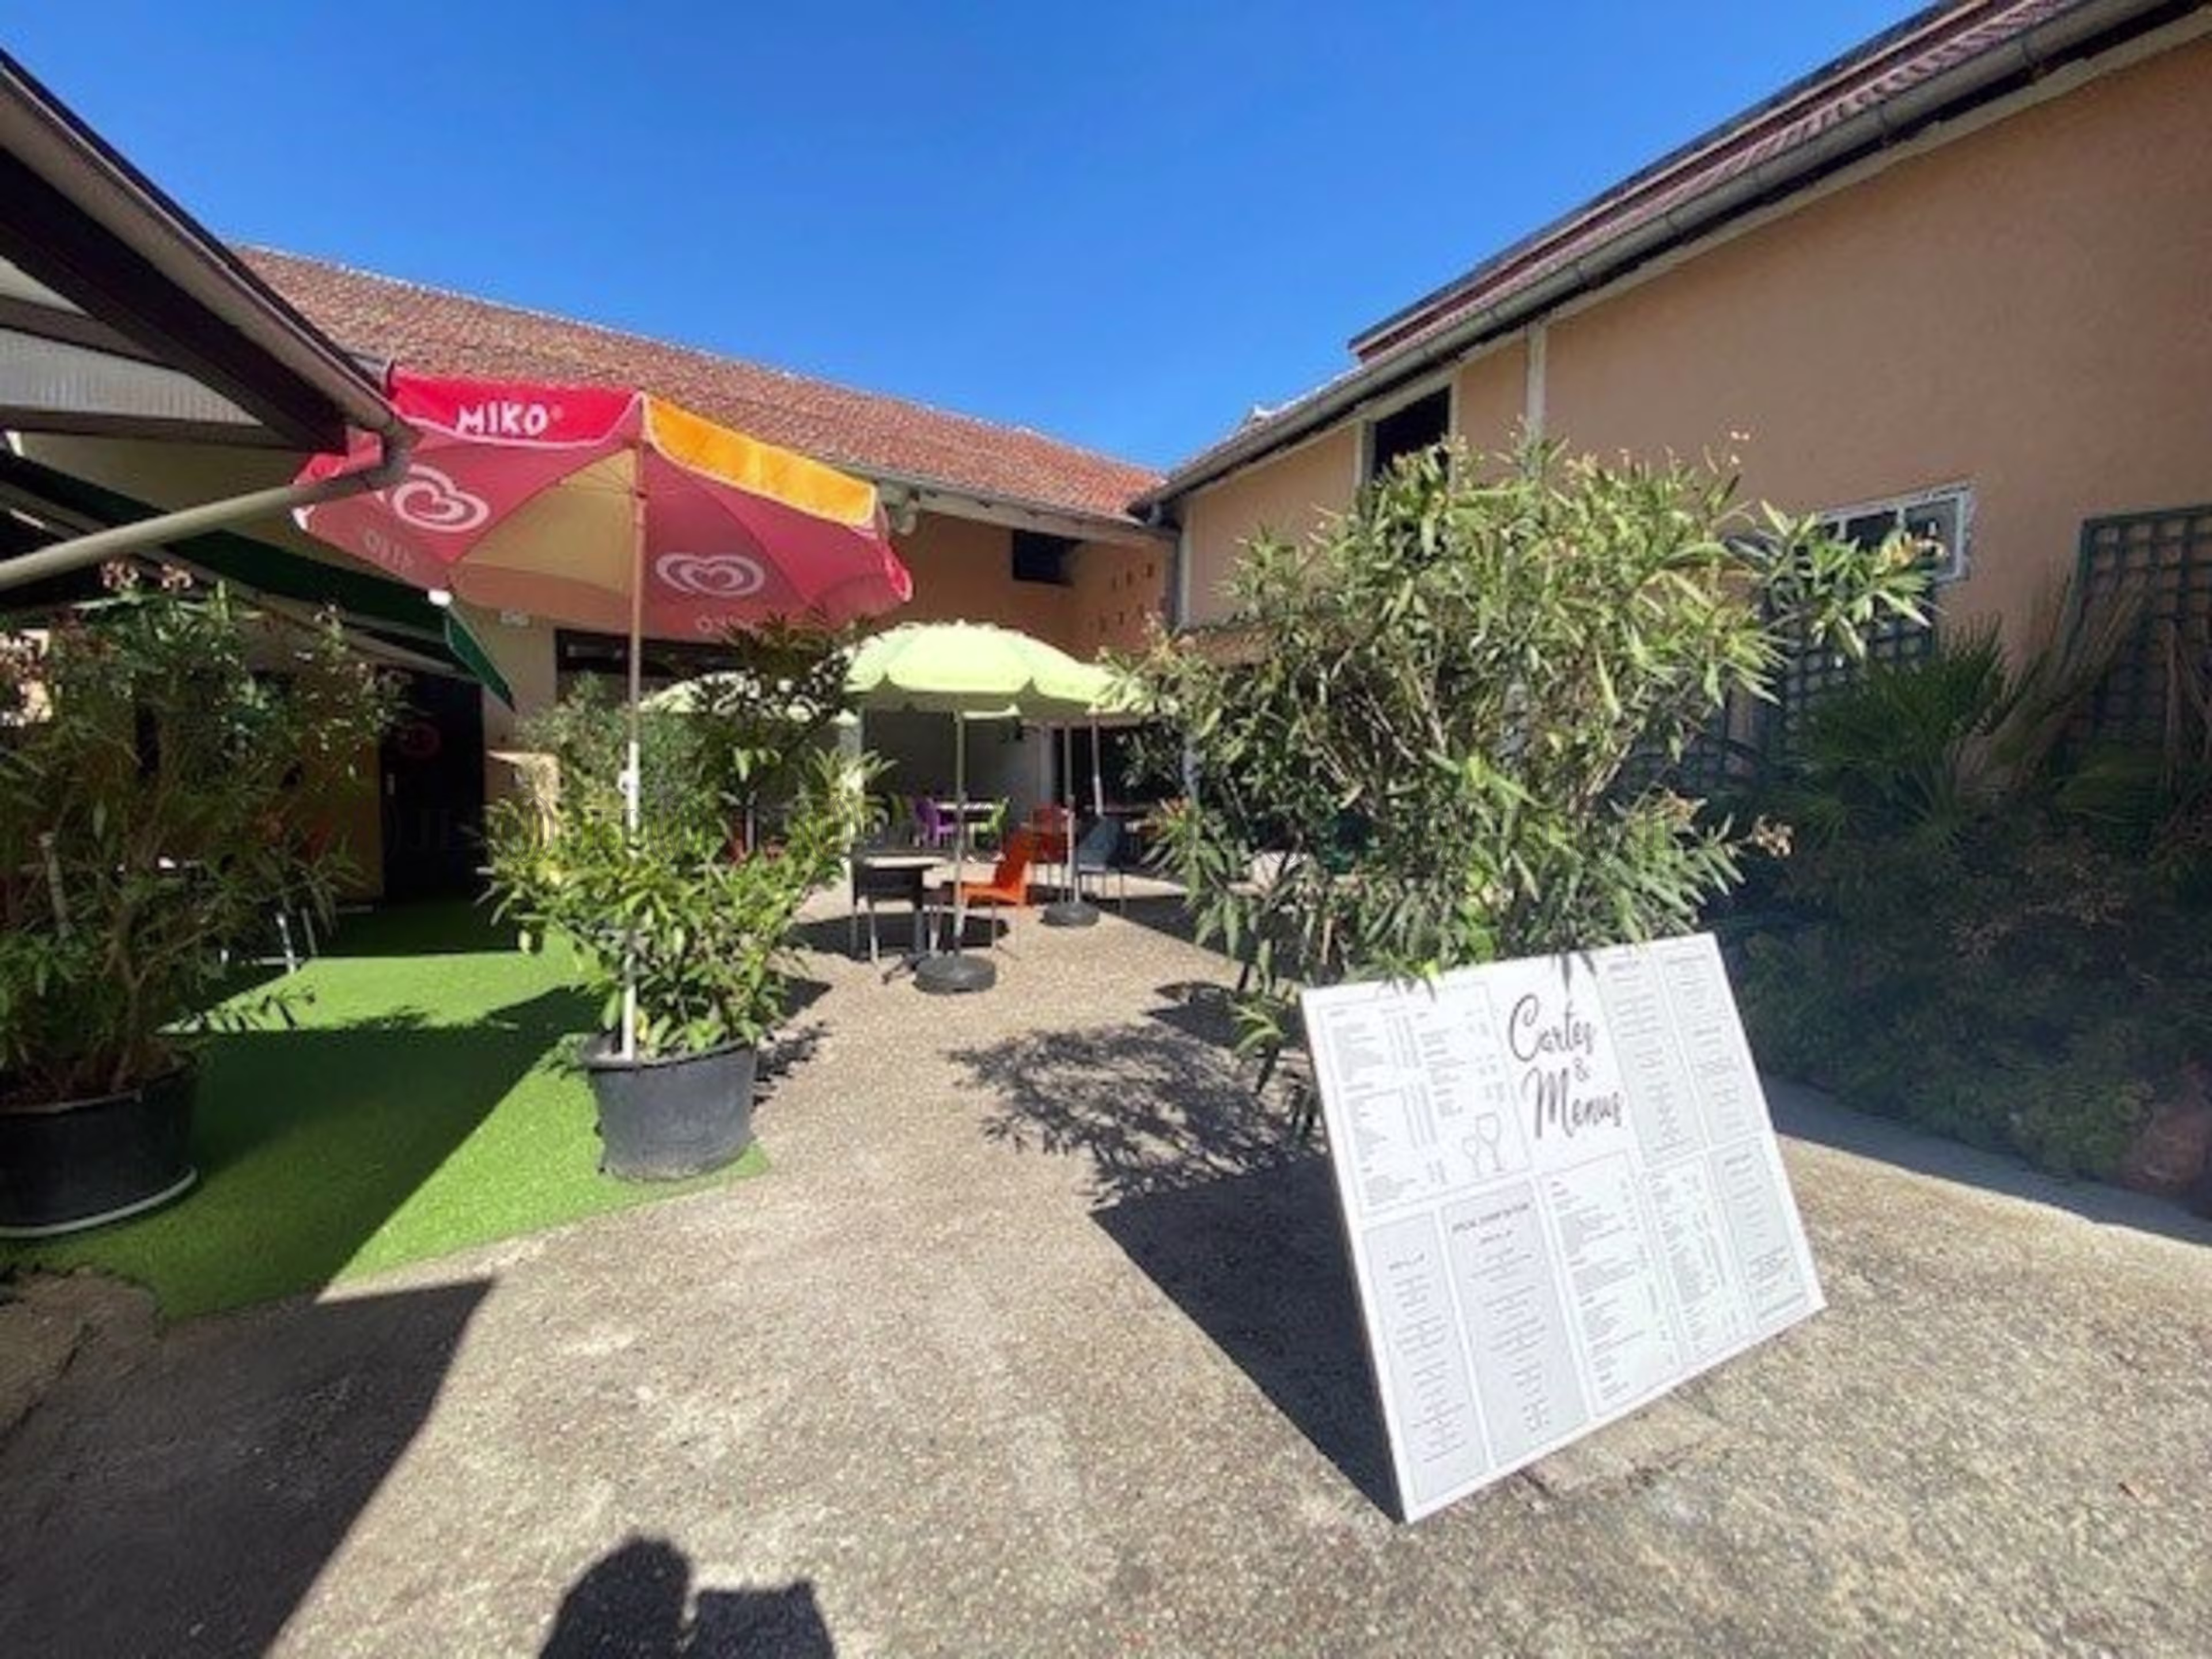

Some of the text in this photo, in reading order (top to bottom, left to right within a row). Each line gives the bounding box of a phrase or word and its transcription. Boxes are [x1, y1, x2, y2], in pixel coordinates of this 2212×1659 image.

[455, 401, 548, 436] MIKO
[1508, 993, 1596, 1062] Cartes
[1572, 1057, 1590, 1082] &
[1520, 1067, 1623, 1139] Menus
